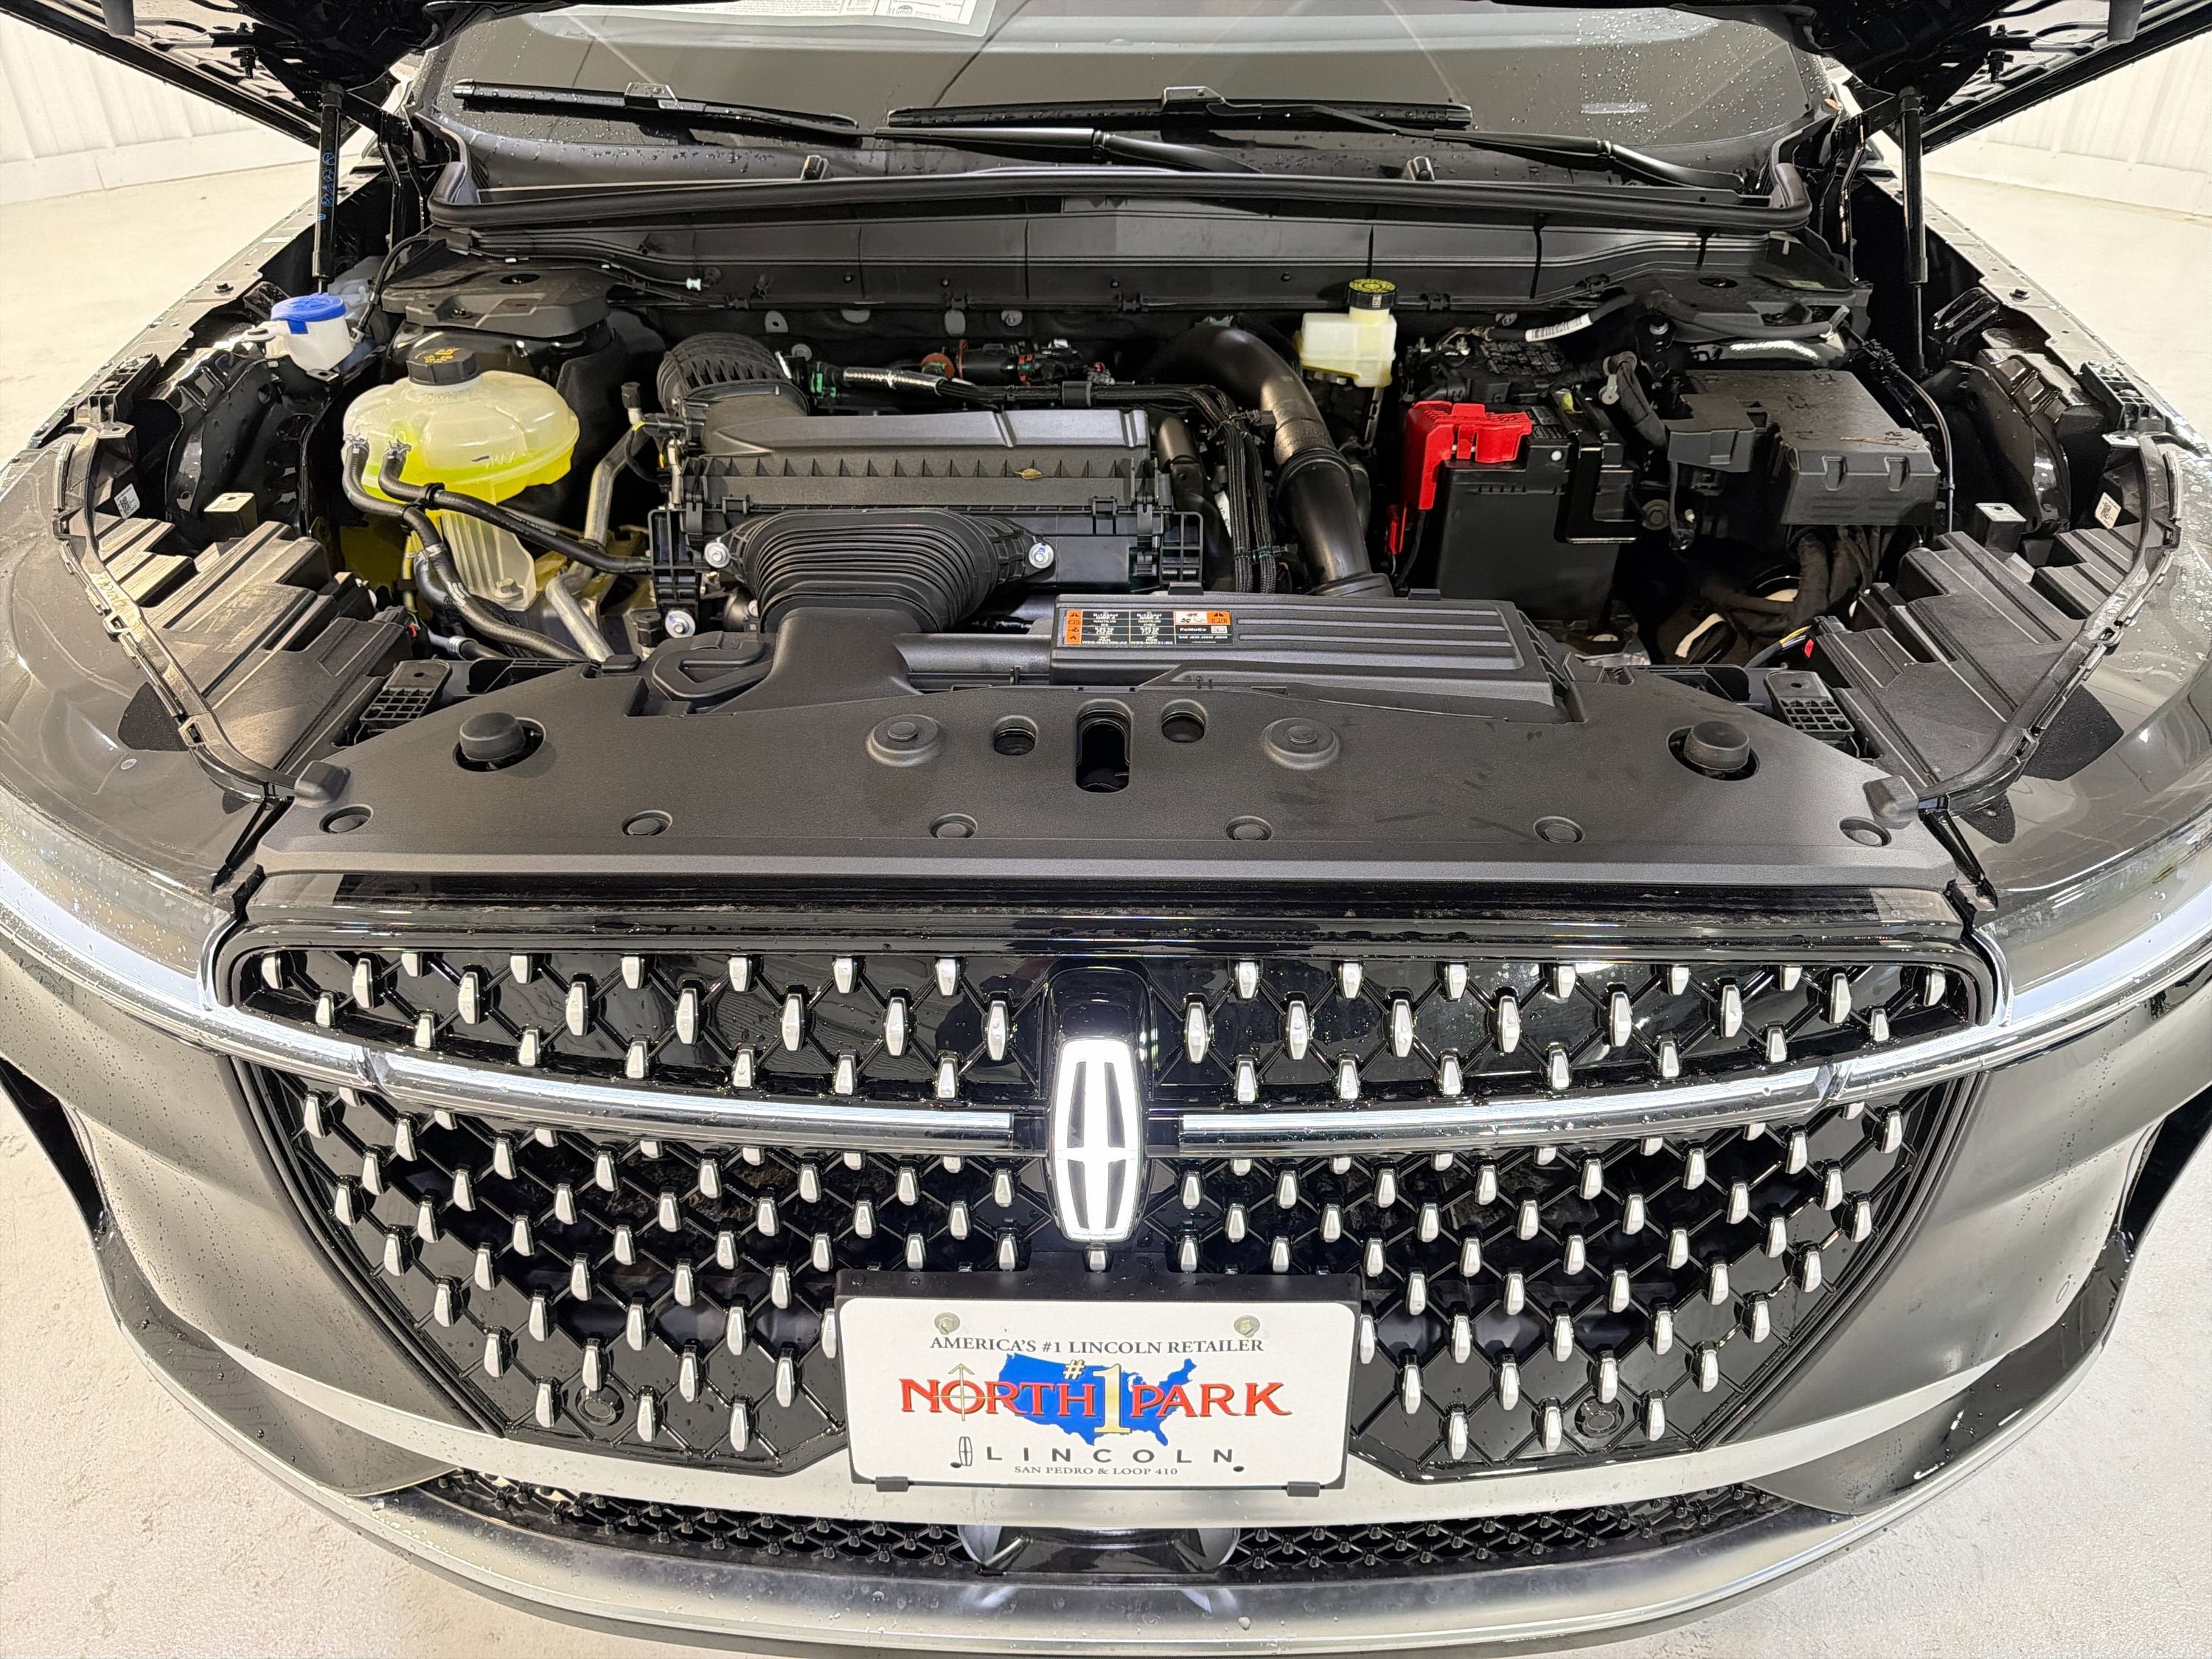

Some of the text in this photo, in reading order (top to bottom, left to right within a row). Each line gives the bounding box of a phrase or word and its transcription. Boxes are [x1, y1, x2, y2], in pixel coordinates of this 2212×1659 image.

[930, 1337, 1265, 1354] AMERICA'S #1 LINCOLN RETAILER
[899, 1378, 1096, 1416] NORTH
[1130, 1382, 1293, 1417] PARK
[987, 1446, 1234, 1464] LINCOLN
[1014, 1465, 1041, 1474] SAN
[1046, 1466, 1093, 1475] PEDRO
[1097, 1467, 1108, 1475] &
[1154, 1467, 1178, 1475] 410
